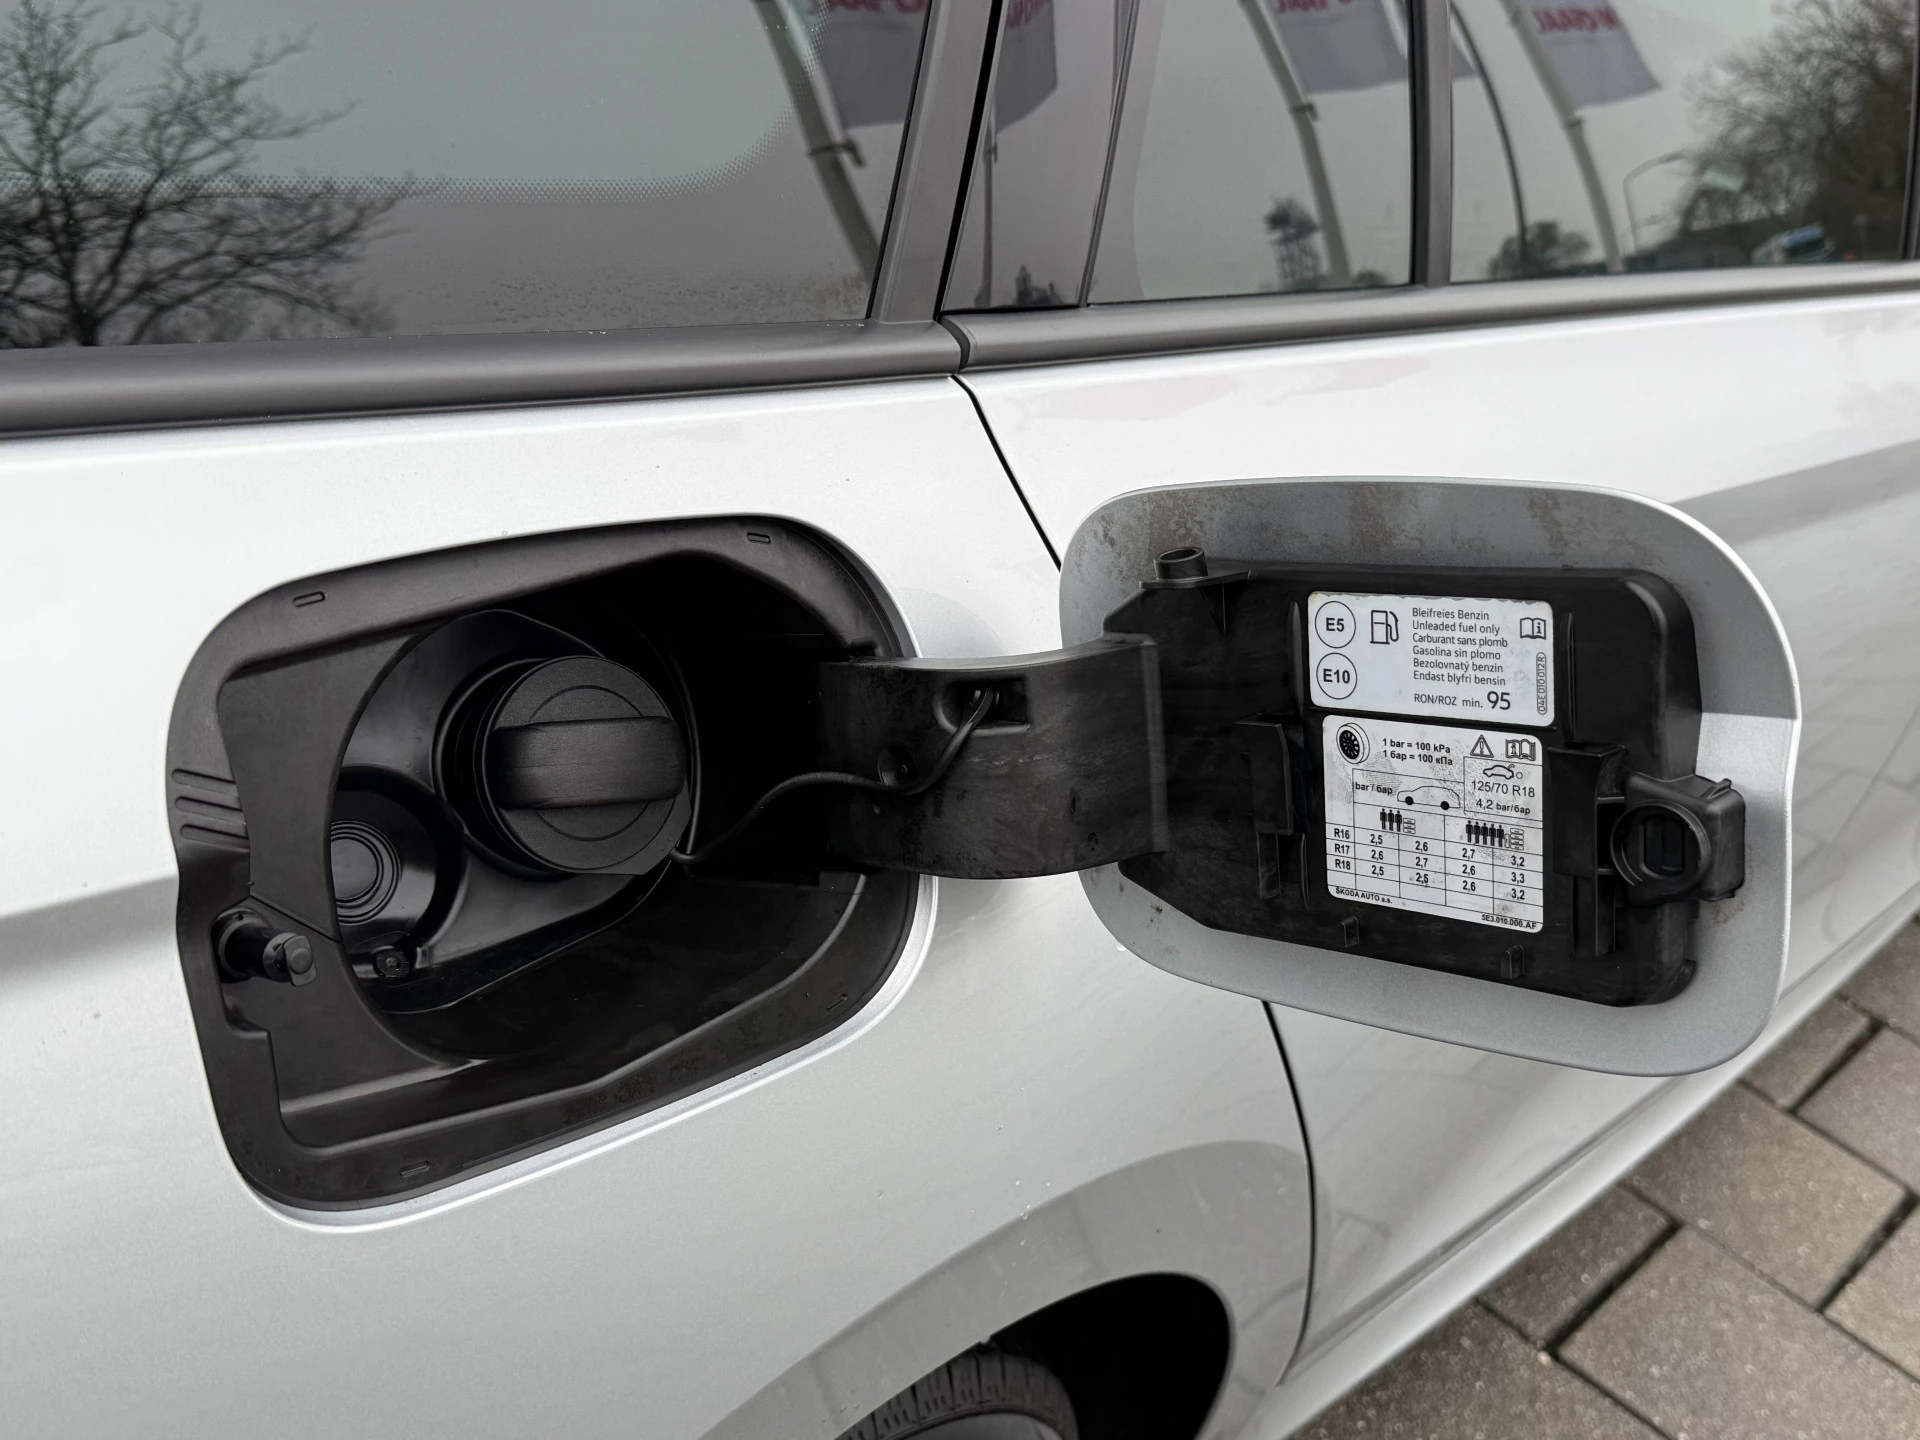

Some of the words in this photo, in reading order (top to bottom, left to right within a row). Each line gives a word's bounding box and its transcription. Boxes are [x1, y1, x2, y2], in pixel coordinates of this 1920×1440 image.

[1412, 608, 1455, 619] Bleifreies
[1457, 610, 1490, 620] Benzin
[1326, 618, 1344, 632] E5
[1412, 622, 1456, 632] Unleaded
[1458, 622, 1477, 633] fuel
[1479, 624, 1500, 636] only
[1413, 634, 1455, 644] Carburant
[1457, 637, 1477, 645] sans
[1479, 636, 1508, 648] plomb
[1413, 646, 1451, 657] Gasolina
[1454, 648, 1468, 658] sin
[1470, 648, 1501, 660] plomo
[1413, 658, 1470, 672] Bezolovnatý
[1472, 662, 1503, 673] benzin
[1323, 670, 1350, 683] E10
[1414, 671, 1445, 681] Endast
[1447, 673, 1472, 684] blyfri
[1474, 674, 1506, 686] bensin
[1414, 694, 1457, 706] RON/ROZ
[1462, 698, 1483, 708] min.
[1487, 691, 1511, 710] 95
[1383, 738, 1386, 746] 1
[1390, 739, 1404, 748] bar
[1416, 742, 1430, 750] 100
[1434, 744, 1450, 753] kPa
[1390, 751, 1406, 761] бар
[1418, 754, 1433, 763] 100
[1436, 757, 1452, 765] кПа
[1355, 782, 1369, 791] bar
[1377, 785, 1392, 795] бар
[1472, 780, 1508, 795] 125/70
[1513, 786, 1535, 797] R18
[1476, 800, 1493, 810] 4,2
[1334, 829, 1350, 839] R16
[1370, 834, 1383, 844] 2,5
[1415, 841, 1428, 852] 2,6
[1462, 848, 1475, 859] 2,7
[1511, 856, 1525, 867] 3,2
[1334, 844, 1350, 854] R17
[1371, 849, 1384, 860] 2,6
[1415, 857, 1428, 868] 2,7
[1462, 864, 1476, 875] 2,6
[1511, 873, 1525, 884] 3,3
[1335, 859, 1351, 870] R18
[1372, 865, 1384, 875] 2,5
[1416, 873, 1429, 884] 2,5
[1463, 880, 1476, 891] 2,6
[1511, 889, 1525, 900] 3,2
[1336, 886, 1359, 897] ŠKODA
[1361, 893, 1379, 901] AUTO
